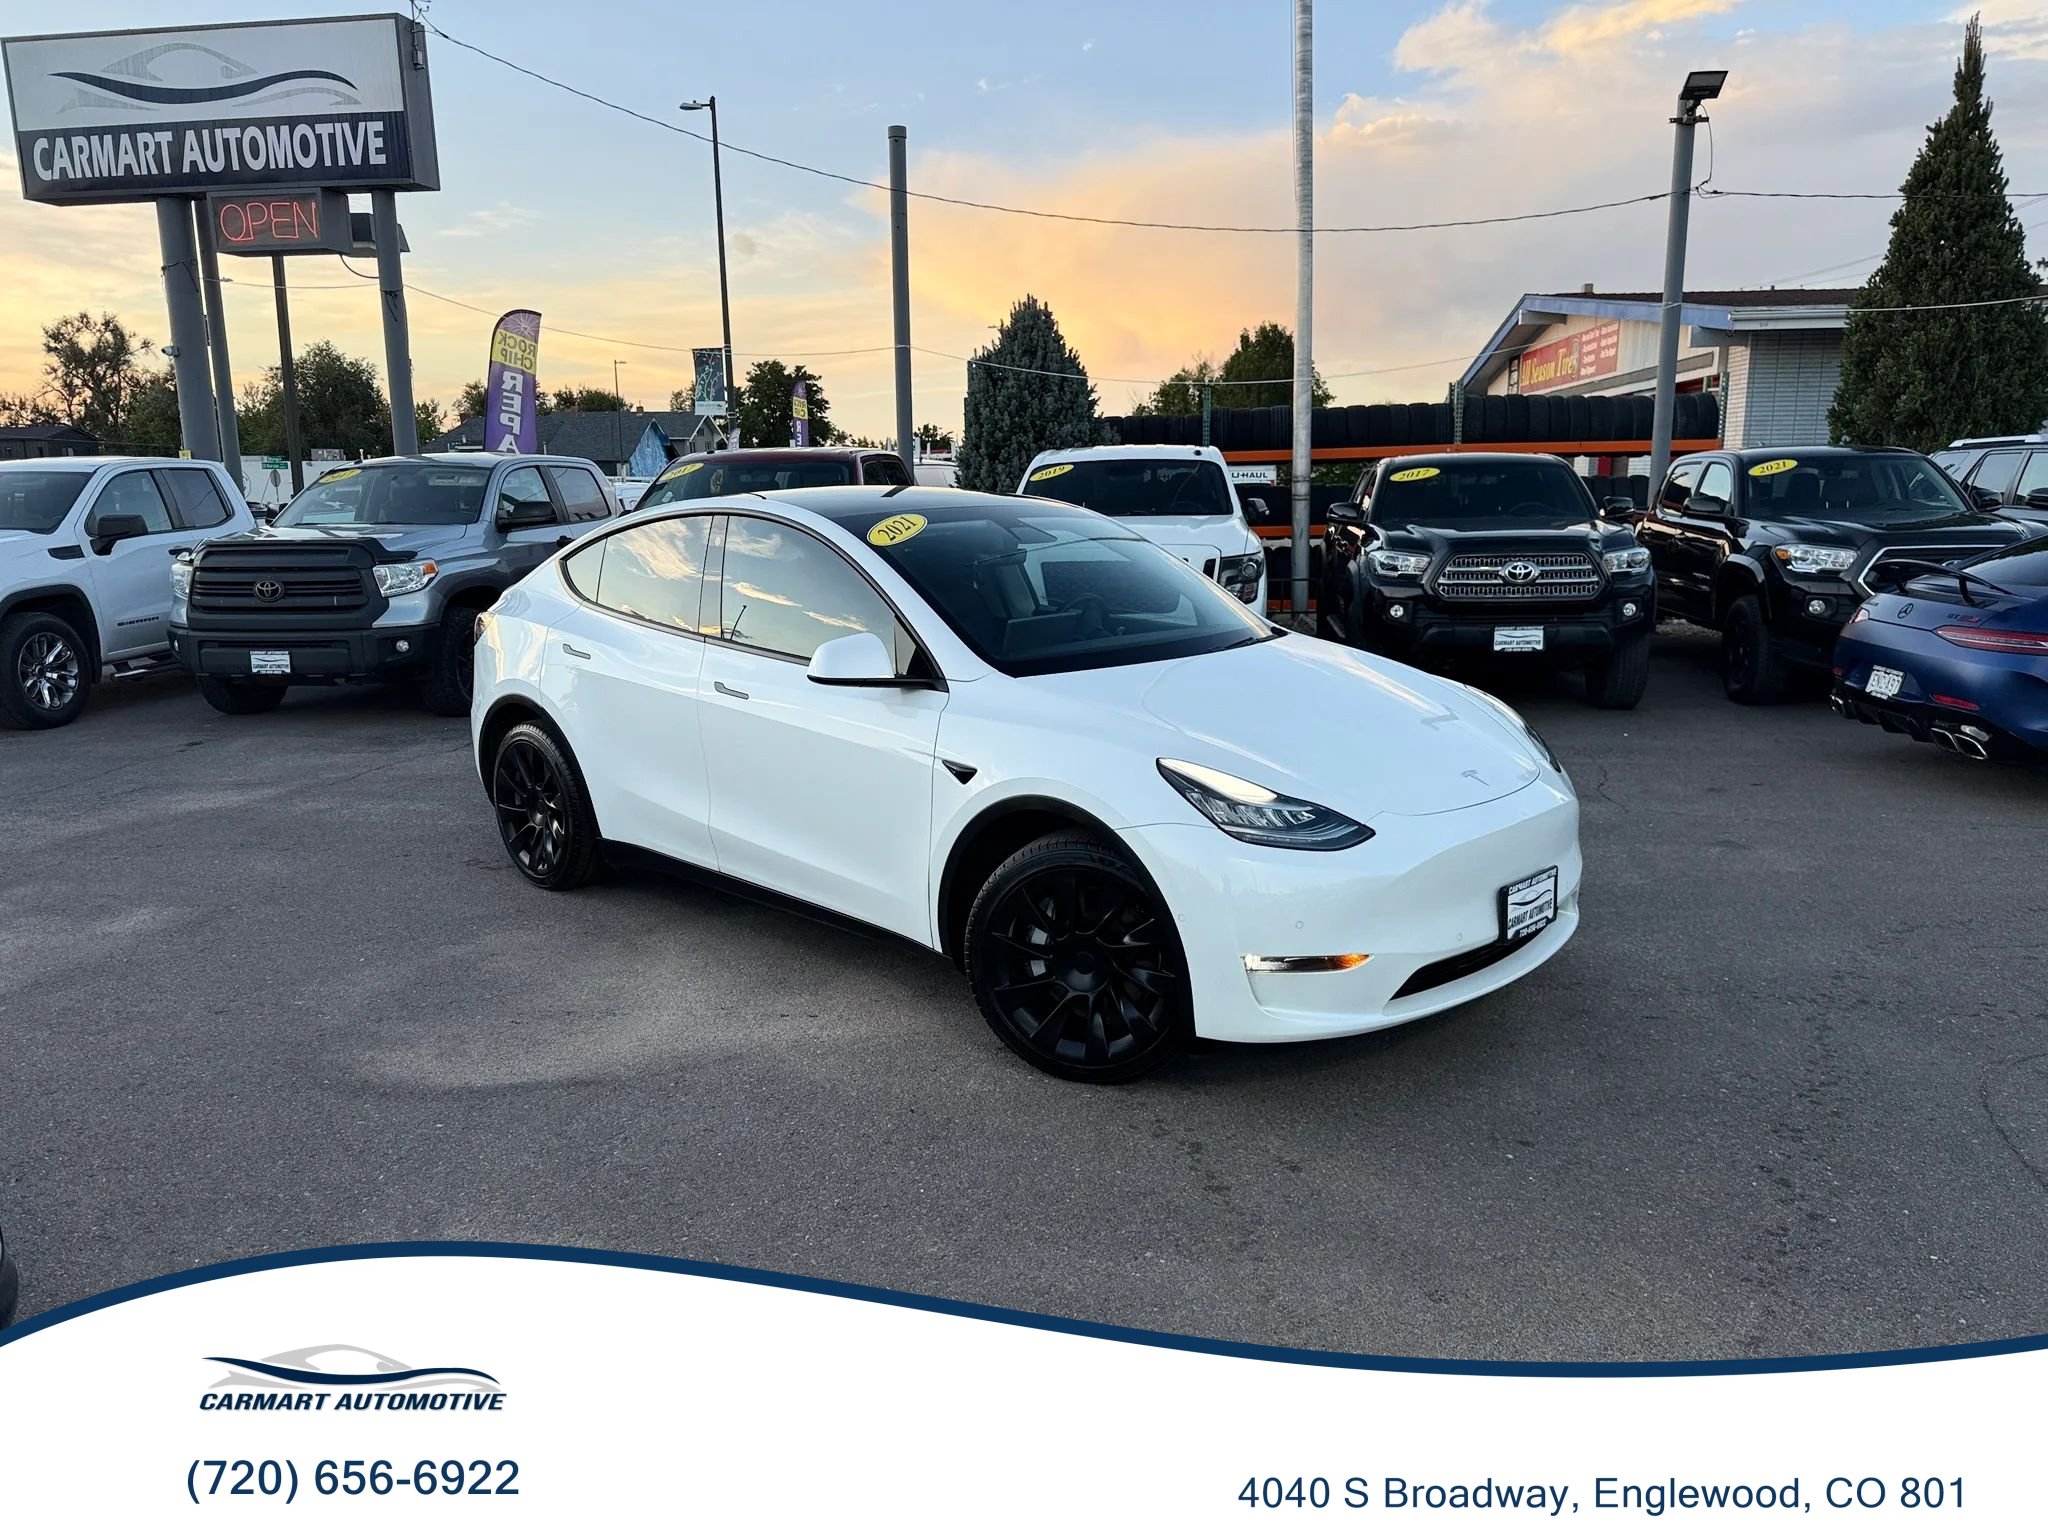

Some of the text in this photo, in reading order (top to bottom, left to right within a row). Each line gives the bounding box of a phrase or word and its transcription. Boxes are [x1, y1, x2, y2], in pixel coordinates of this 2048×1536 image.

[33, 121, 387, 181] CARMART AUTOMOTIVE
[220, 201, 318, 241] OPEN
[1531, 357, 1556, 384] Season
[1039, 466, 1065, 479] 2019
[1398, 469, 1430, 480] 2017
[1759, 460, 1786, 474] 2021
[877, 516, 918, 542] 2021
